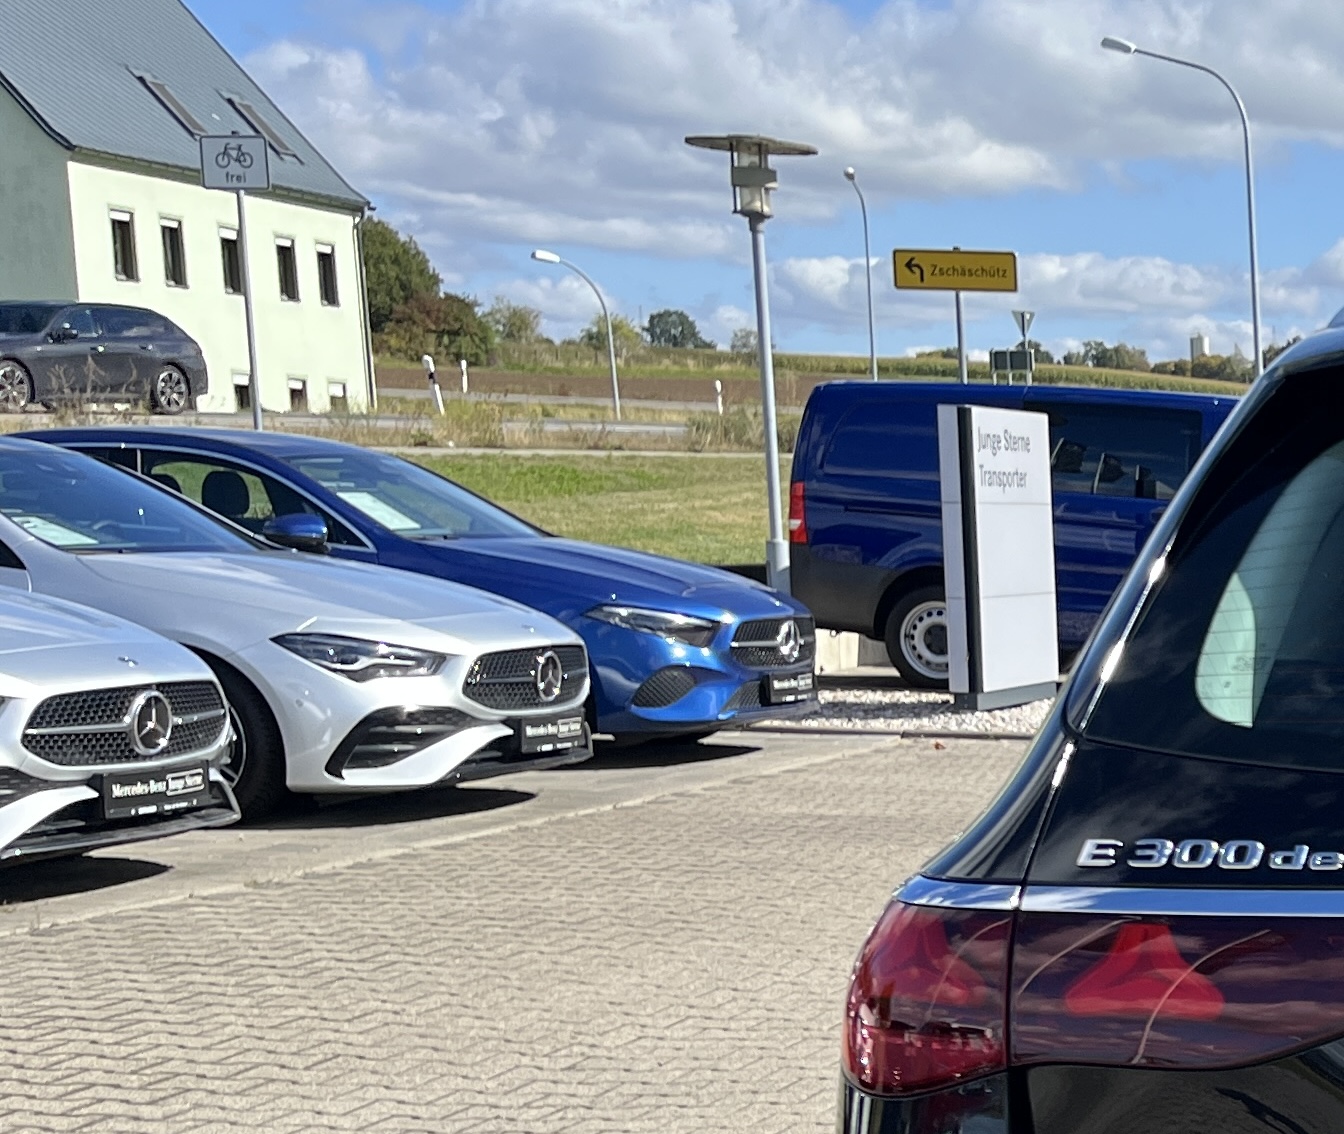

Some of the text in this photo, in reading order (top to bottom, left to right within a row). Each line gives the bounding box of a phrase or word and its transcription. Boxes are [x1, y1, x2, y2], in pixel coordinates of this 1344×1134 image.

[226, 171, 246, 183] frei
[930, 264, 1008, 278] Zschäschütz
[978, 427, 1031, 456] Junge Sterne
[979, 464, 1027, 493] Transporter
[1076, 839, 1123, 867] E
